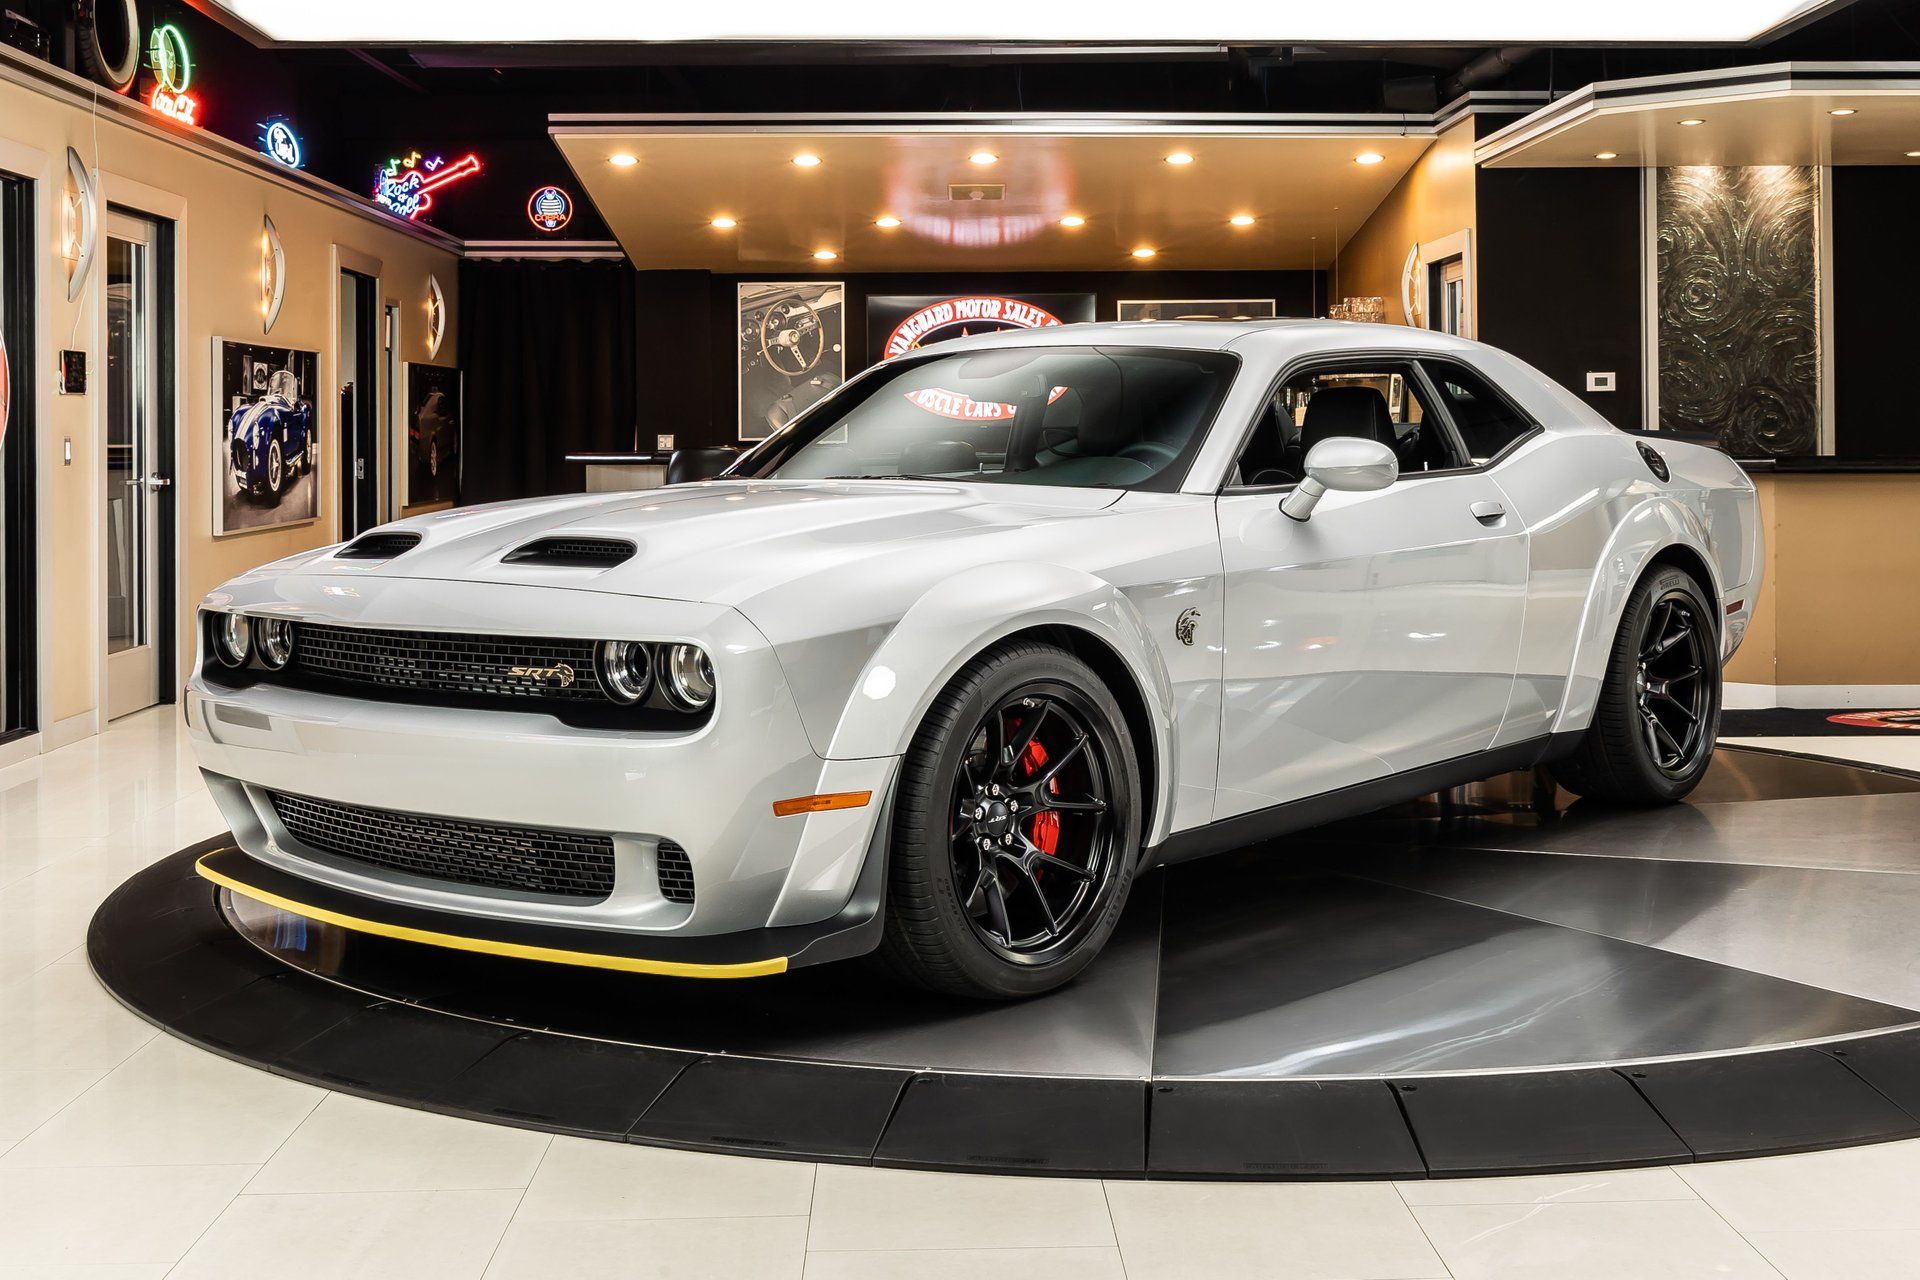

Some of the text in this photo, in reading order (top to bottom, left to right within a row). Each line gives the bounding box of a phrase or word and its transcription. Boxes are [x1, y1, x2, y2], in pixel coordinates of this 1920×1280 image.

[383, 174, 419, 197] Rock
[534, 214, 566, 222] COBRA
[888, 299, 1045, 354] VANGUARD MOTOR SALES
[908, 390, 962, 416] USCLE
[964, 398, 1001, 418] CARS
[507, 666, 560, 680] SRT
